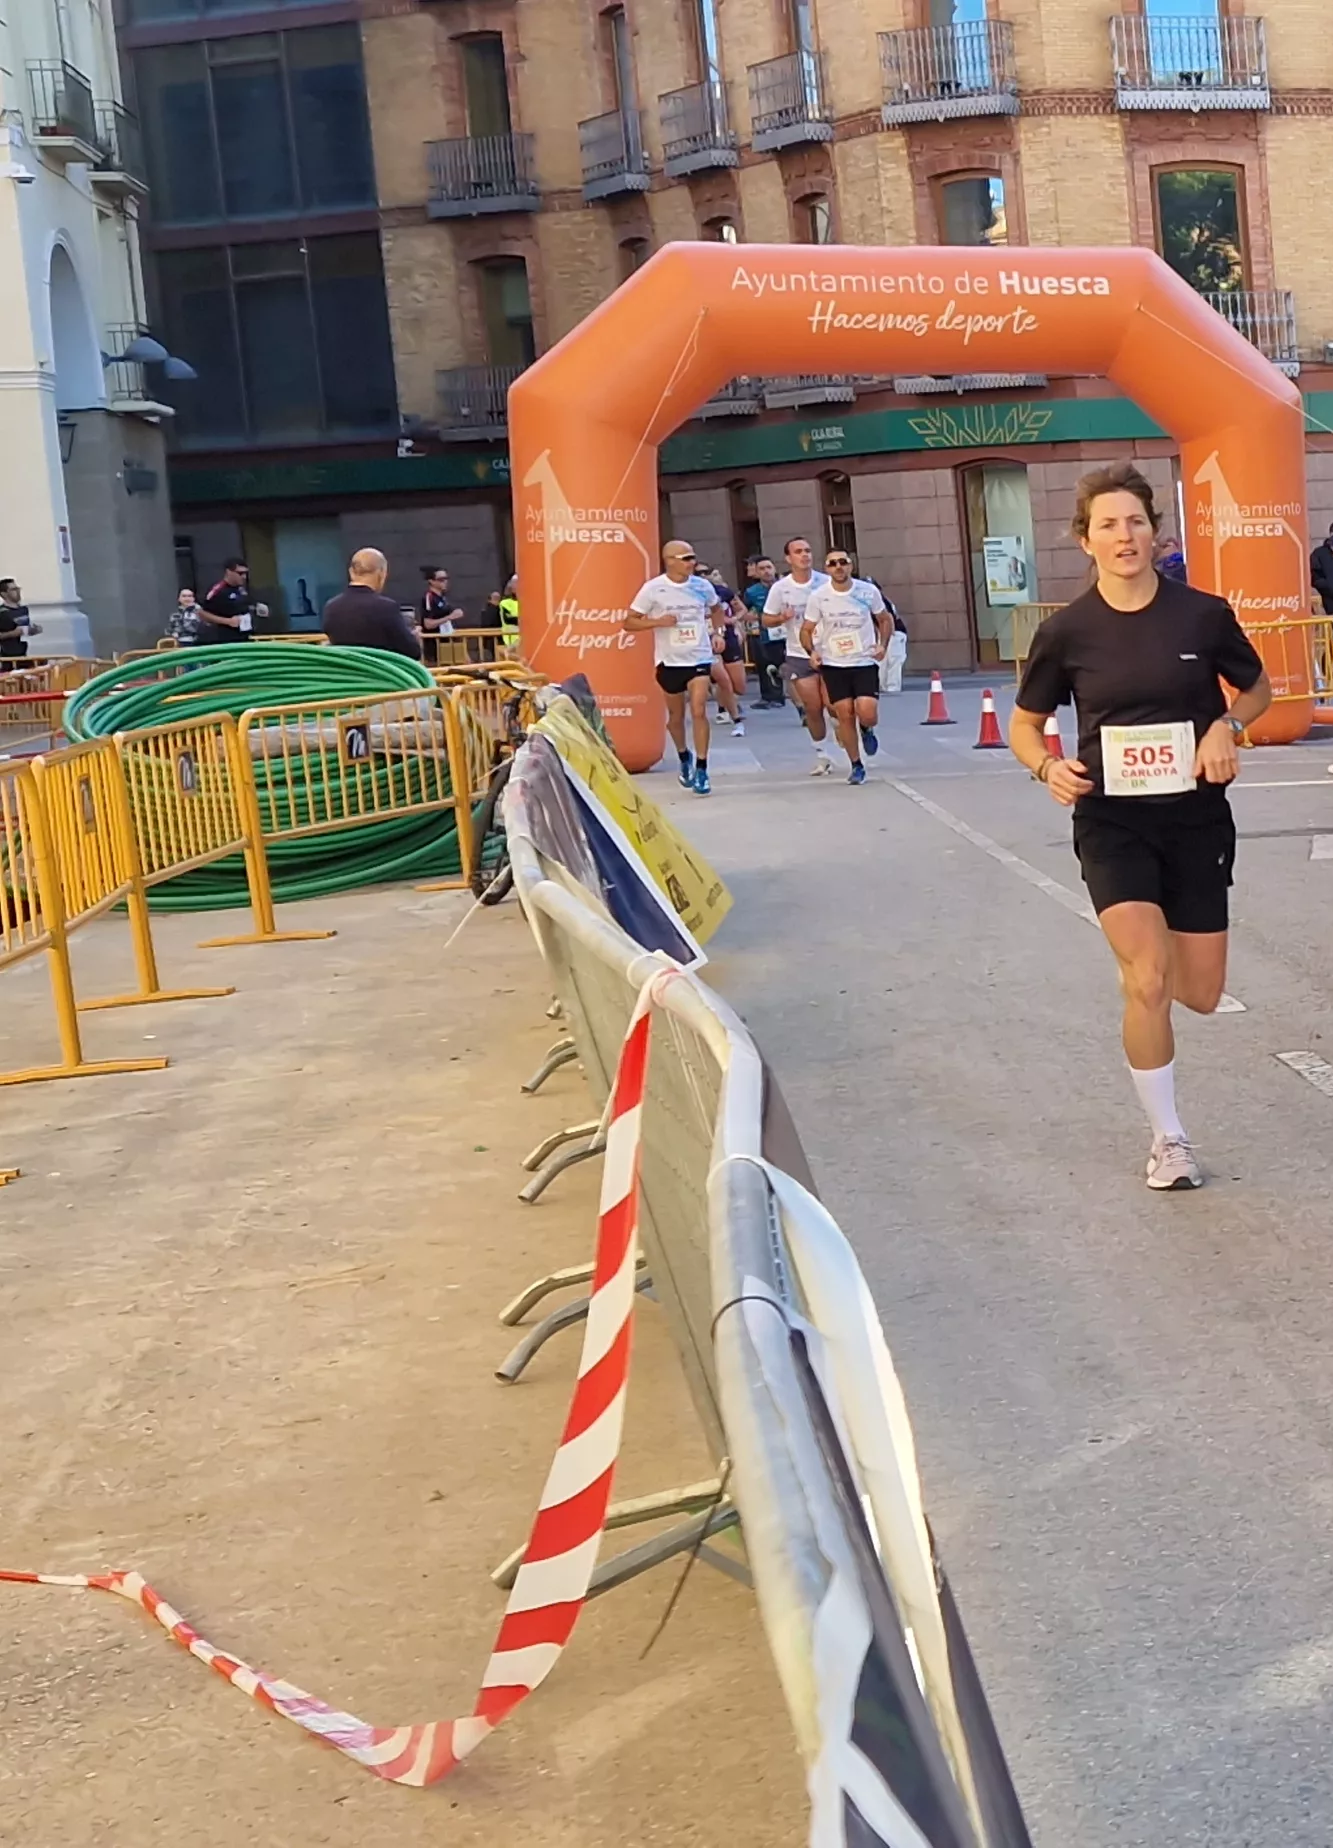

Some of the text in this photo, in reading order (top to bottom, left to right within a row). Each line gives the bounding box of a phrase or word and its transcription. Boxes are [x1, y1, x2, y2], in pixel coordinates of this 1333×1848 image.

[732, 266, 1110, 297] Ayuntamiento de Huesca
[808, 300, 1039, 345] Hacemos deporte
[525, 504, 648, 525] Ayuntamiento
[1196, 501, 1301, 524] Ayuntamiento
[527, 525, 625, 544] de Huesca
[1197, 522, 1283, 537] de Huesca
[556, 599, 628, 624] Hacem
[556, 625, 637, 660] deporte
[1123, 745, 1174, 766] 505
[1121, 767, 1178, 778] CARLOTA
